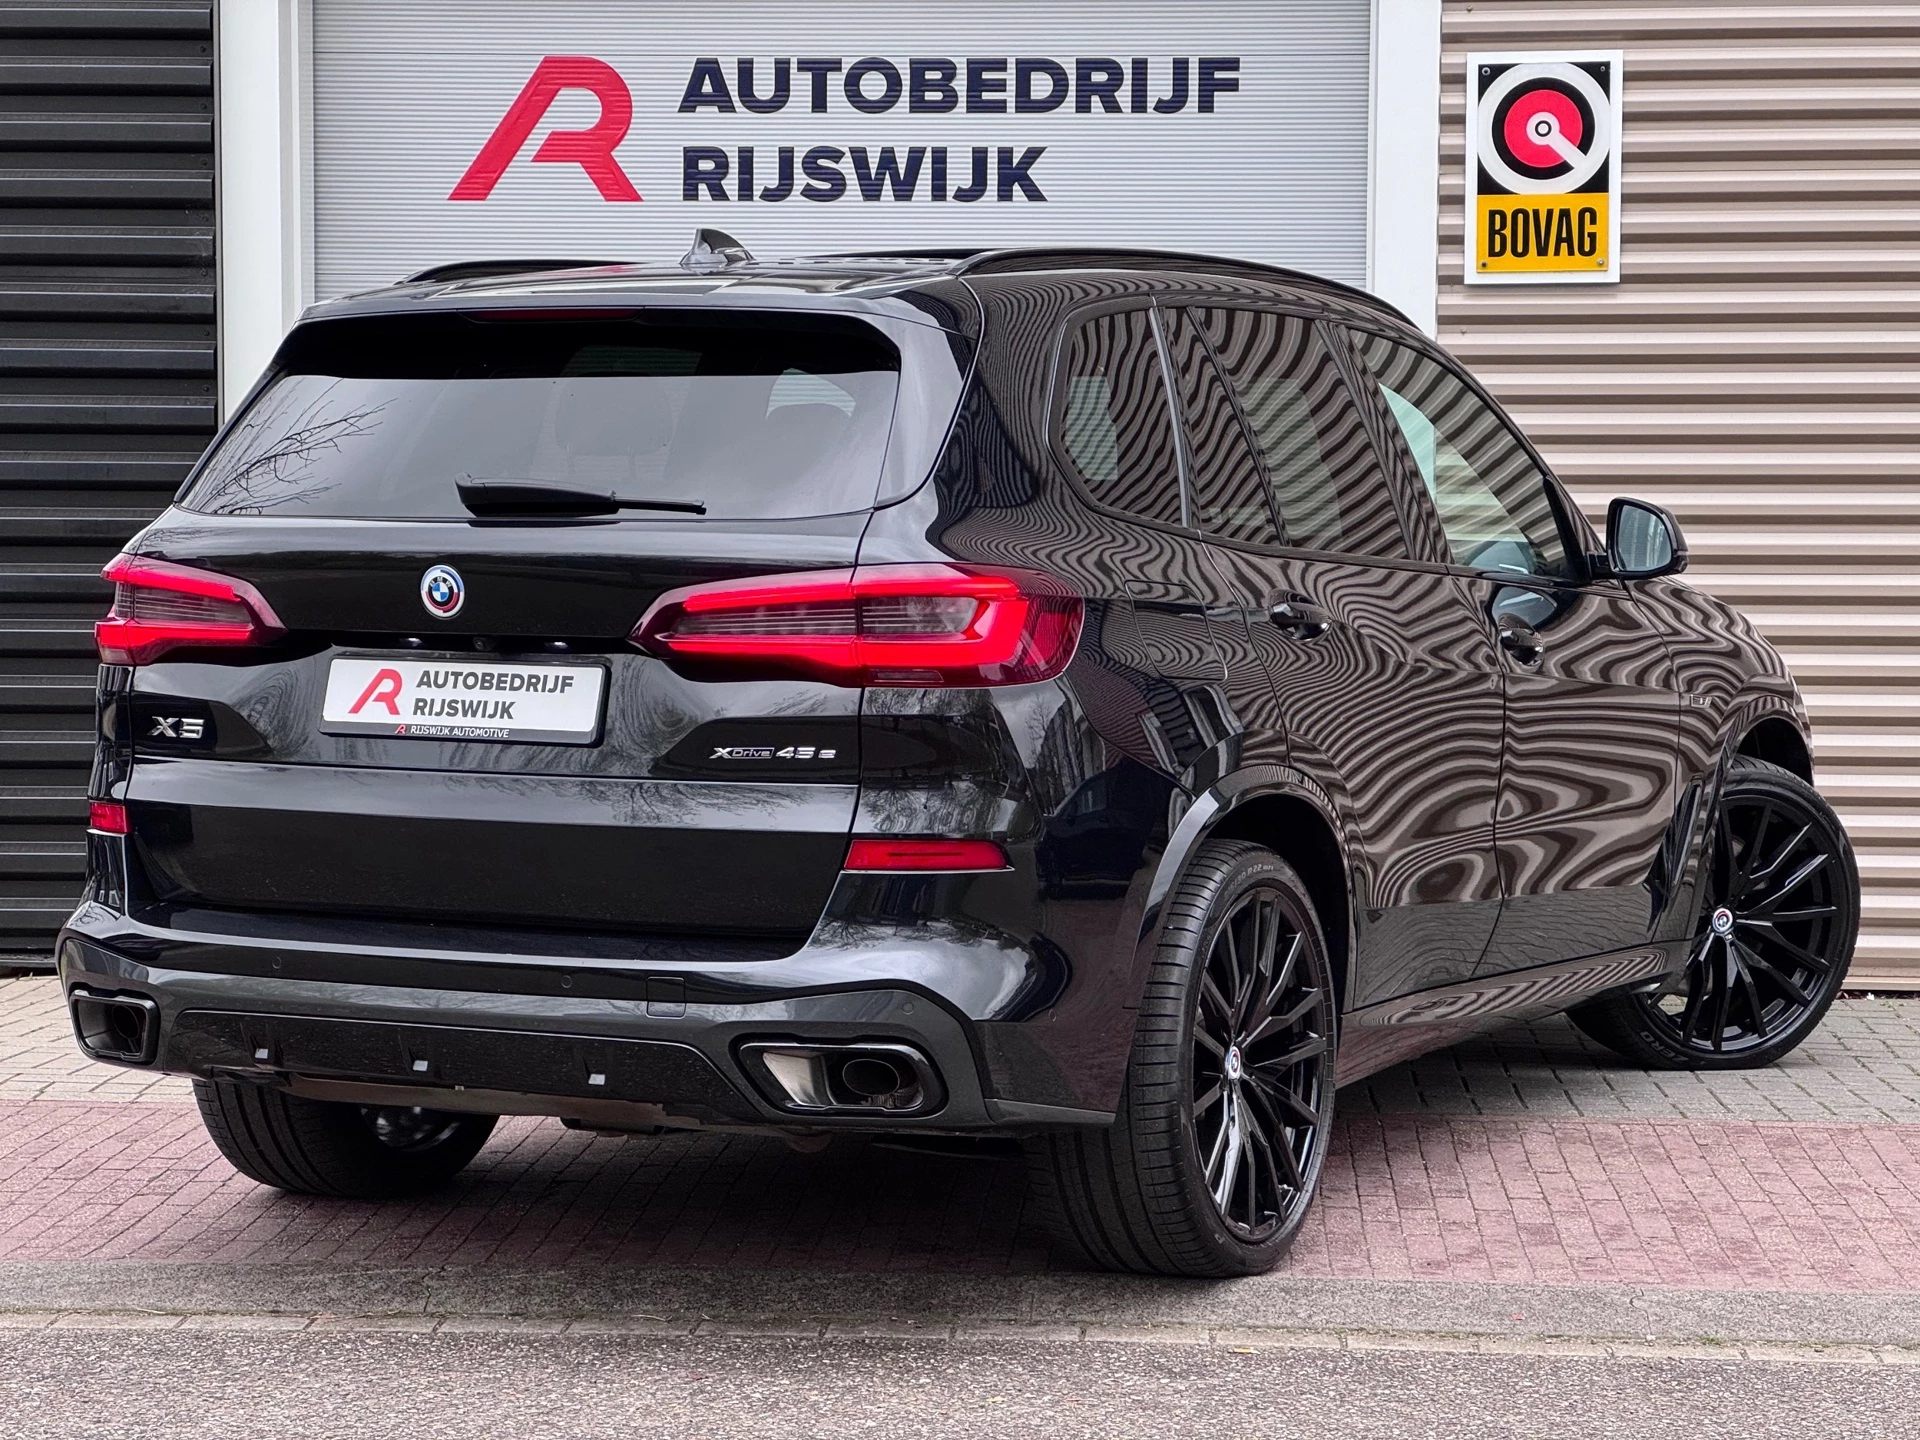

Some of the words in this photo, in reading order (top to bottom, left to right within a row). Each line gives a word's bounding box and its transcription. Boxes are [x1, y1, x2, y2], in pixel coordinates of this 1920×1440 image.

[677, 57, 1241, 114] AUTOBEDRIJF
[682, 146, 1048, 203] RIJSWIJK
[1488, 207, 1597, 258] BOVAG
[416, 670, 574, 694] AUTOBEDRIJF
[412, 697, 515, 720] RIJSWIJK
[148, 715, 205, 739] X5
[410, 725, 451, 736] RIJSWIJK
[452, 727, 510, 738] AUTOMOTIVE
